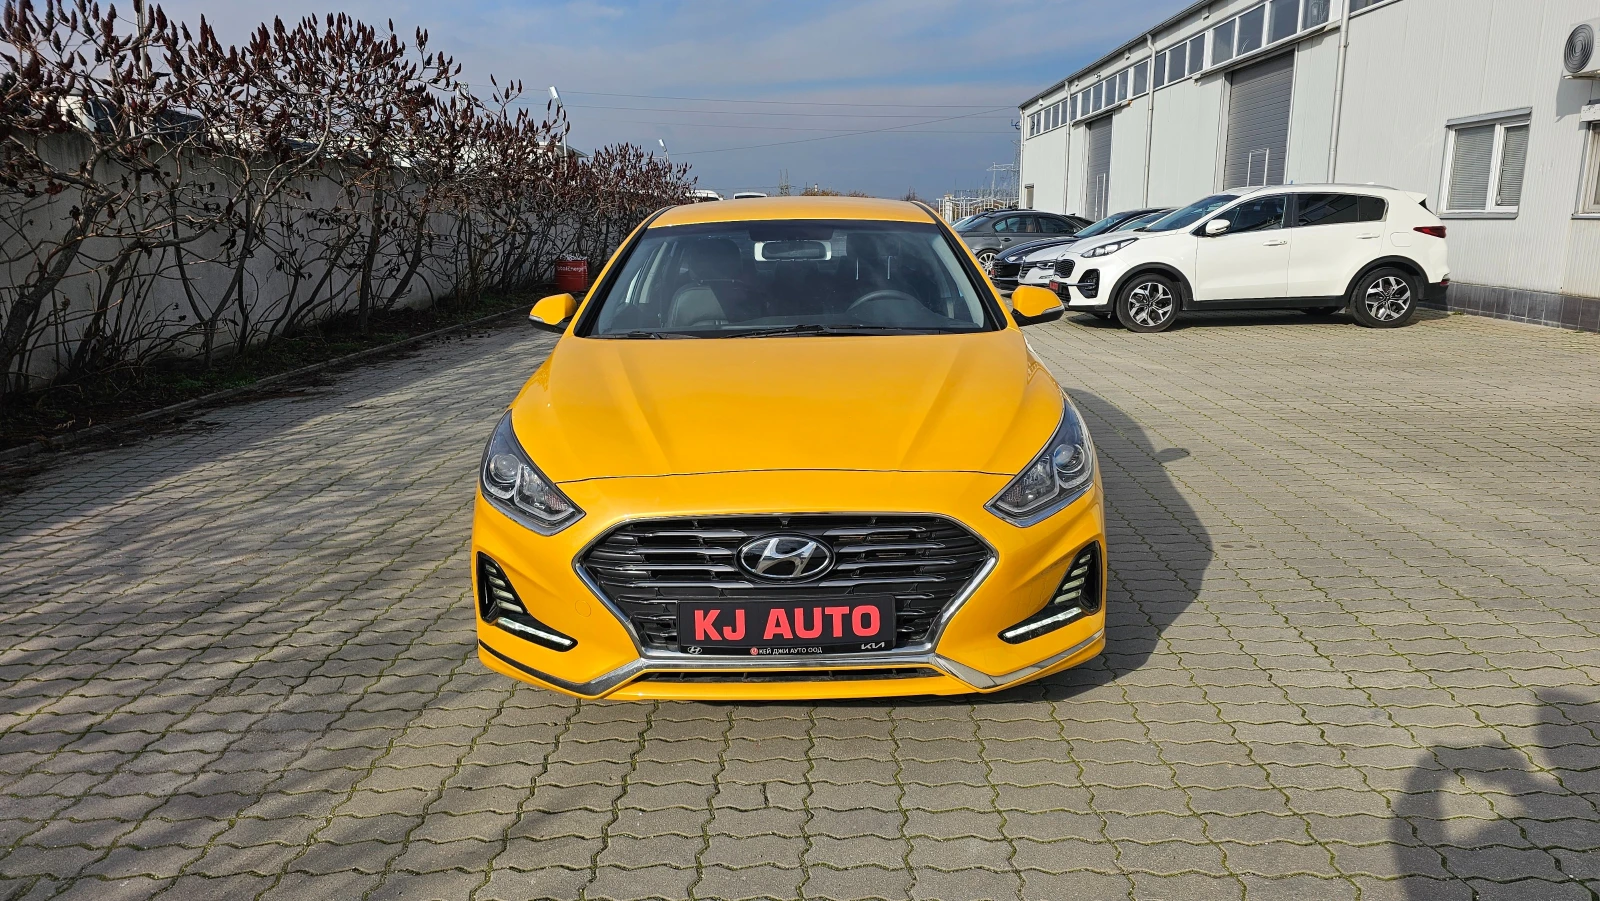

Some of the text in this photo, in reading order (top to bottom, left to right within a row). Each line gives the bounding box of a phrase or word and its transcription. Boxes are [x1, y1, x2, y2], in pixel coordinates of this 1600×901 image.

[694, 605, 881, 641] KJ AUTO
[759, 647, 772, 655] КЕЙ
[808, 646, 823, 654] ООД
